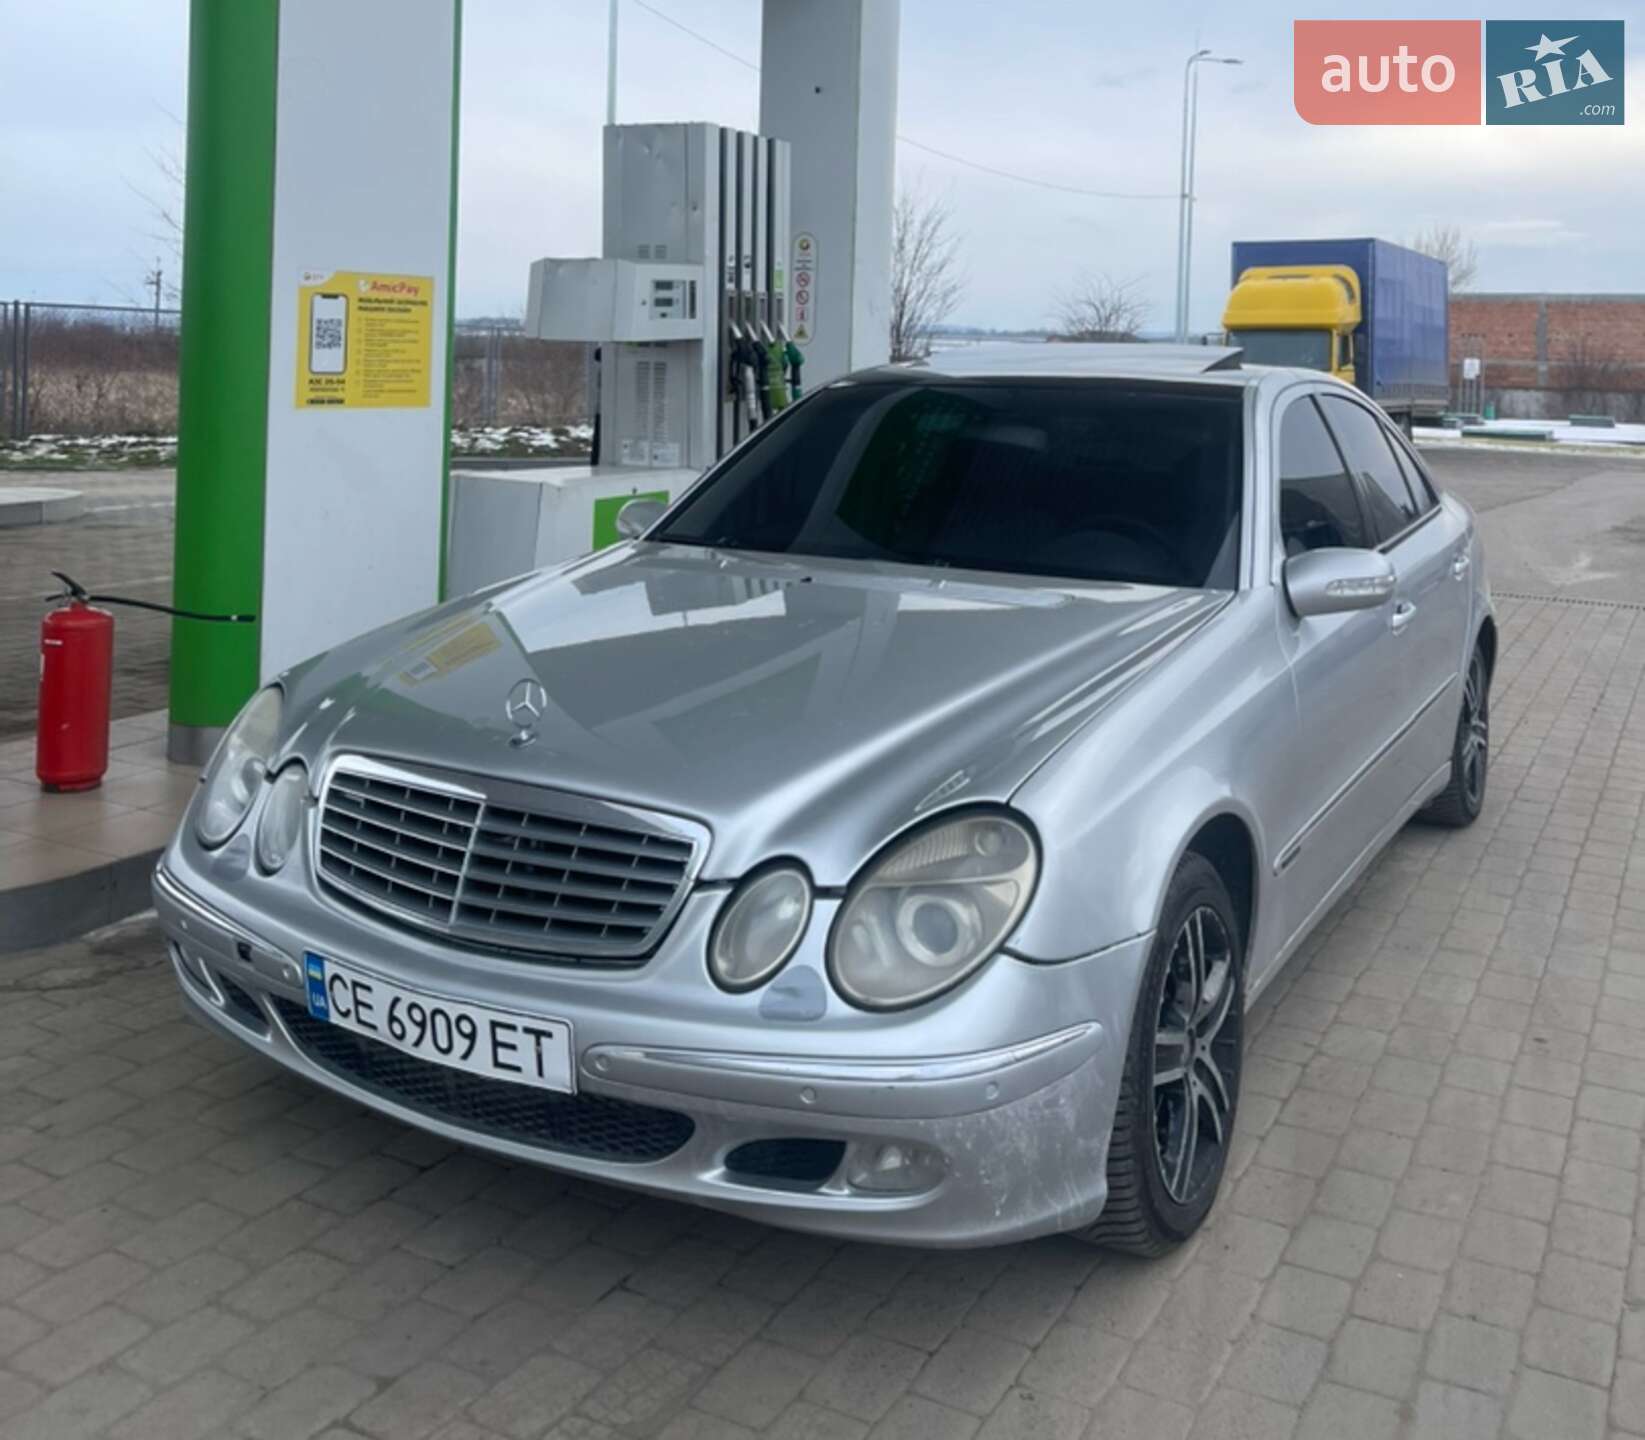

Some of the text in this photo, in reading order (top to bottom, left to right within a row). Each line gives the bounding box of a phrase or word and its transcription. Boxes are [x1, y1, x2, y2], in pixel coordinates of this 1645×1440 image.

[370, 280, 419, 297] AmicPay
[328, 973, 553, 1078] CE 6909 ET
